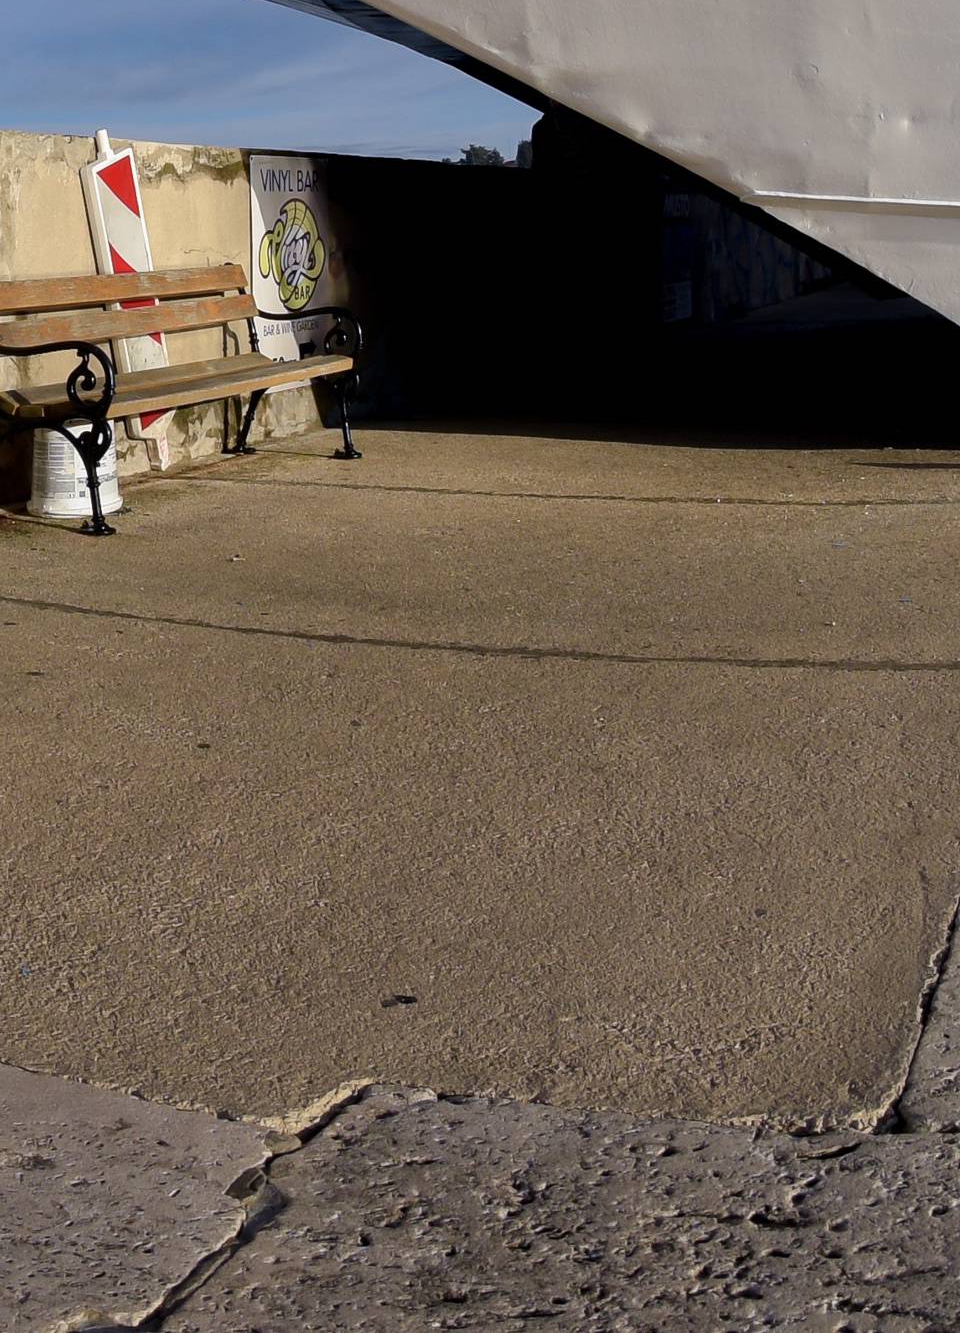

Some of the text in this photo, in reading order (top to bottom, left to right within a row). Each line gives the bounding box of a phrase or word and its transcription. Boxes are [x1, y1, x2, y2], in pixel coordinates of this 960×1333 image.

[260, 169, 320, 192] VINYL BAR
[294, 285, 311, 300] BAR
[263, 324, 274, 337] BAR
